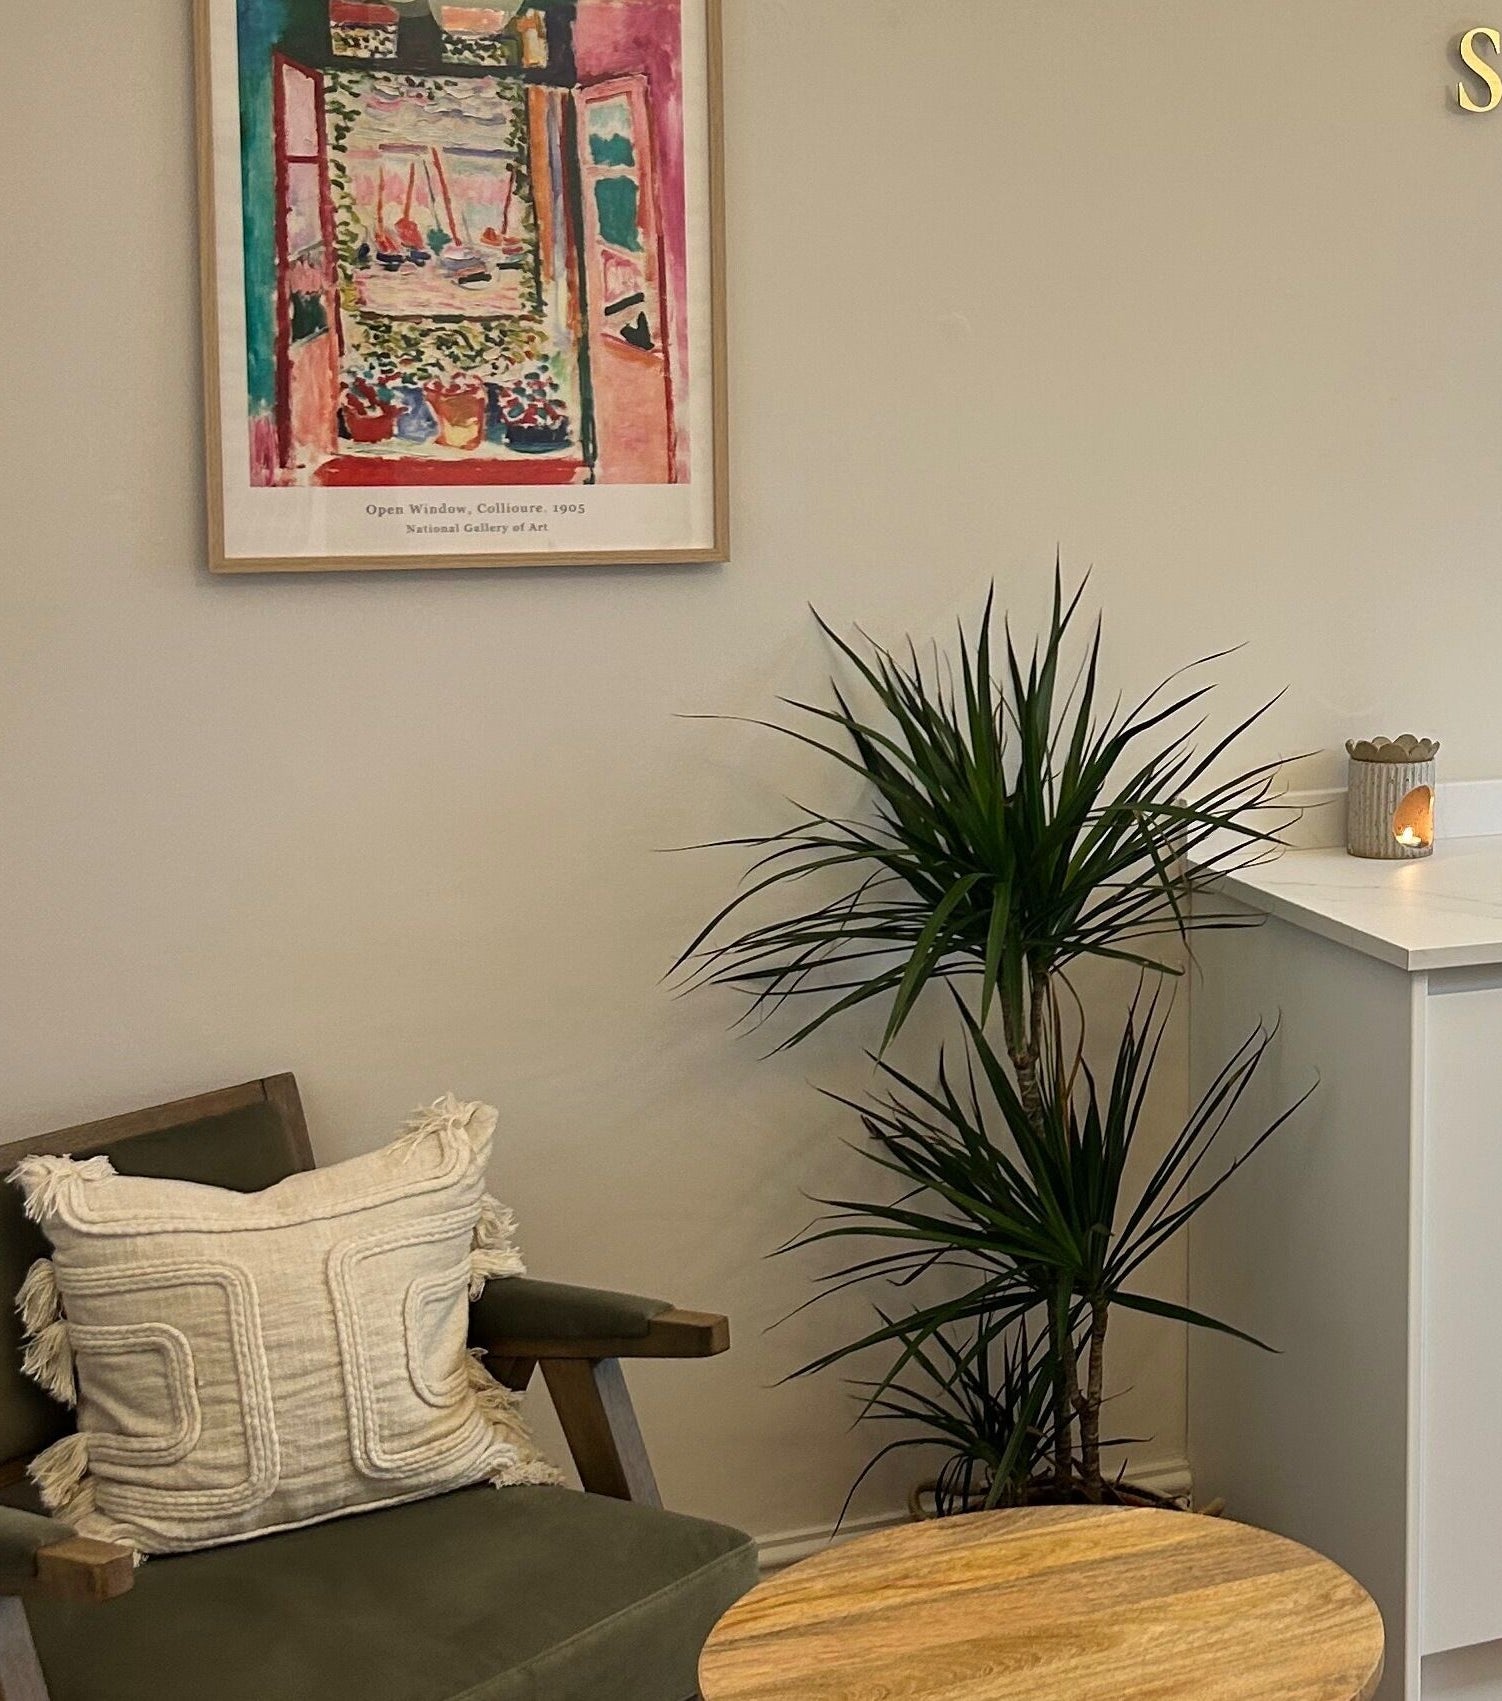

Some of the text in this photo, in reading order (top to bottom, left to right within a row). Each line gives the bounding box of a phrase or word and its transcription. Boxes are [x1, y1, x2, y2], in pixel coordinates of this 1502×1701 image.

[366, 504, 404, 517] Open
[409, 503, 472, 515] Window,
[553, 503, 585, 515] 1905
[406, 522, 548, 534] National Gallery of Art
